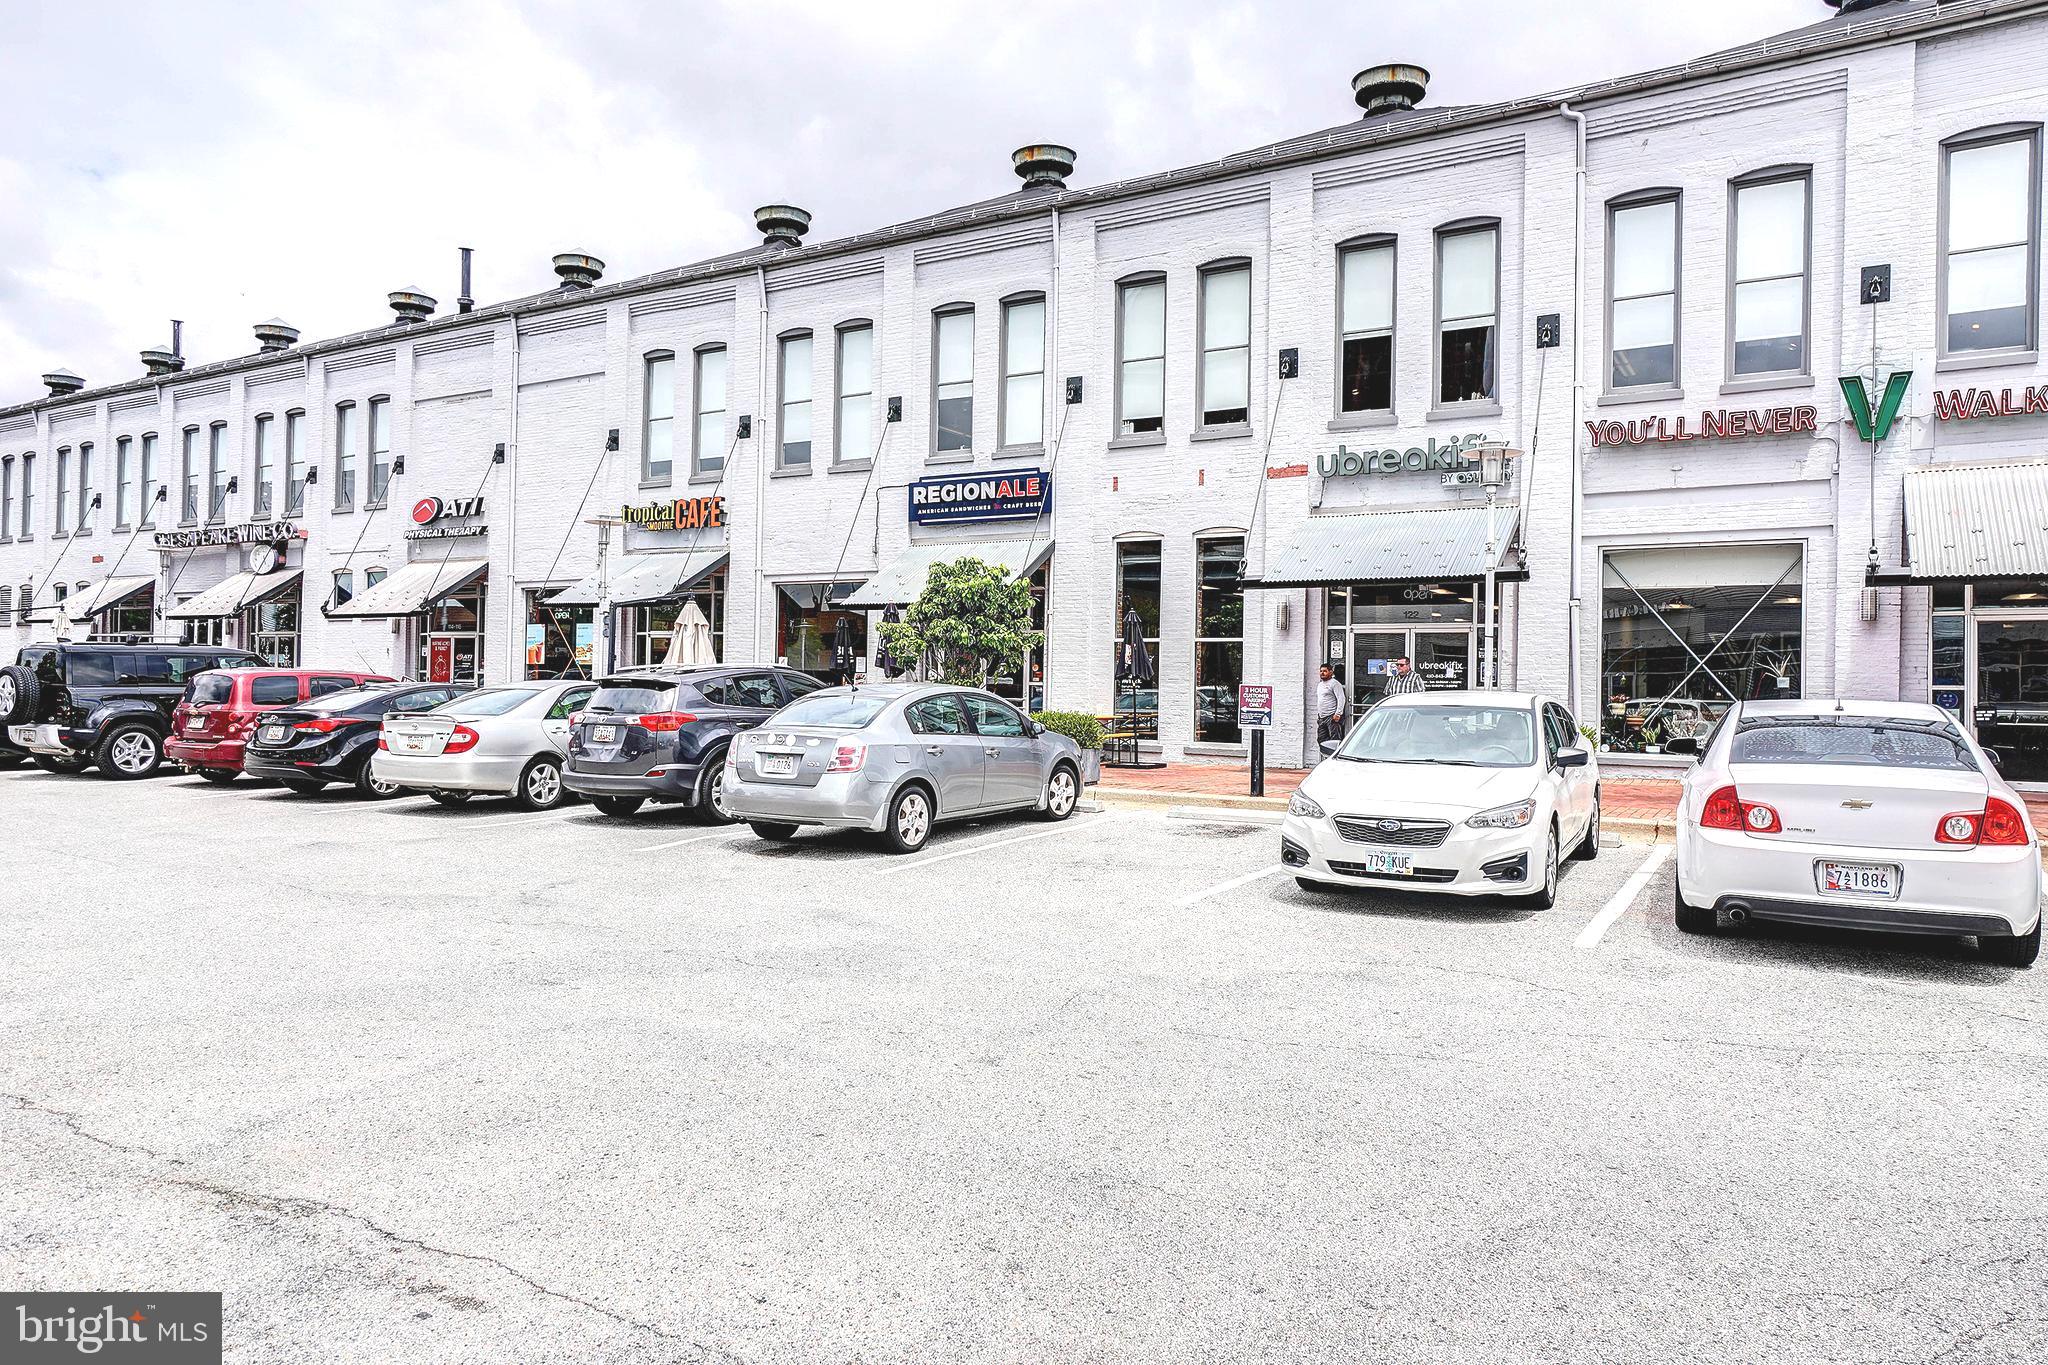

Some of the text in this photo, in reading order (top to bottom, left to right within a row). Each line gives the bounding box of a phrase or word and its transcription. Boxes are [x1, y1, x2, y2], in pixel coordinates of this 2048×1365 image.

[1934, 385, 2048, 421] WALK
[1585, 406, 1817, 447] YOU'LL NEVER
[1316, 433, 1510, 478] ubreakif
[1440, 473, 1453, 483] BY
[913, 478, 1040, 505] REGIONALE
[439, 497, 485, 519] ATI
[621, 497, 724, 529] tropical CAFE
[951, 505, 991, 513] SANDWICHES
[237, 523, 273, 543] WINE
[403, 525, 485, 540] PHYSICAL THERAPY
[646, 521, 673, 531] SMOOTHIE
[554, 612, 570, 620] OPEN
[1419, 661, 1463, 670] ubreakifix
[1368, 855, 1386, 868] 779
